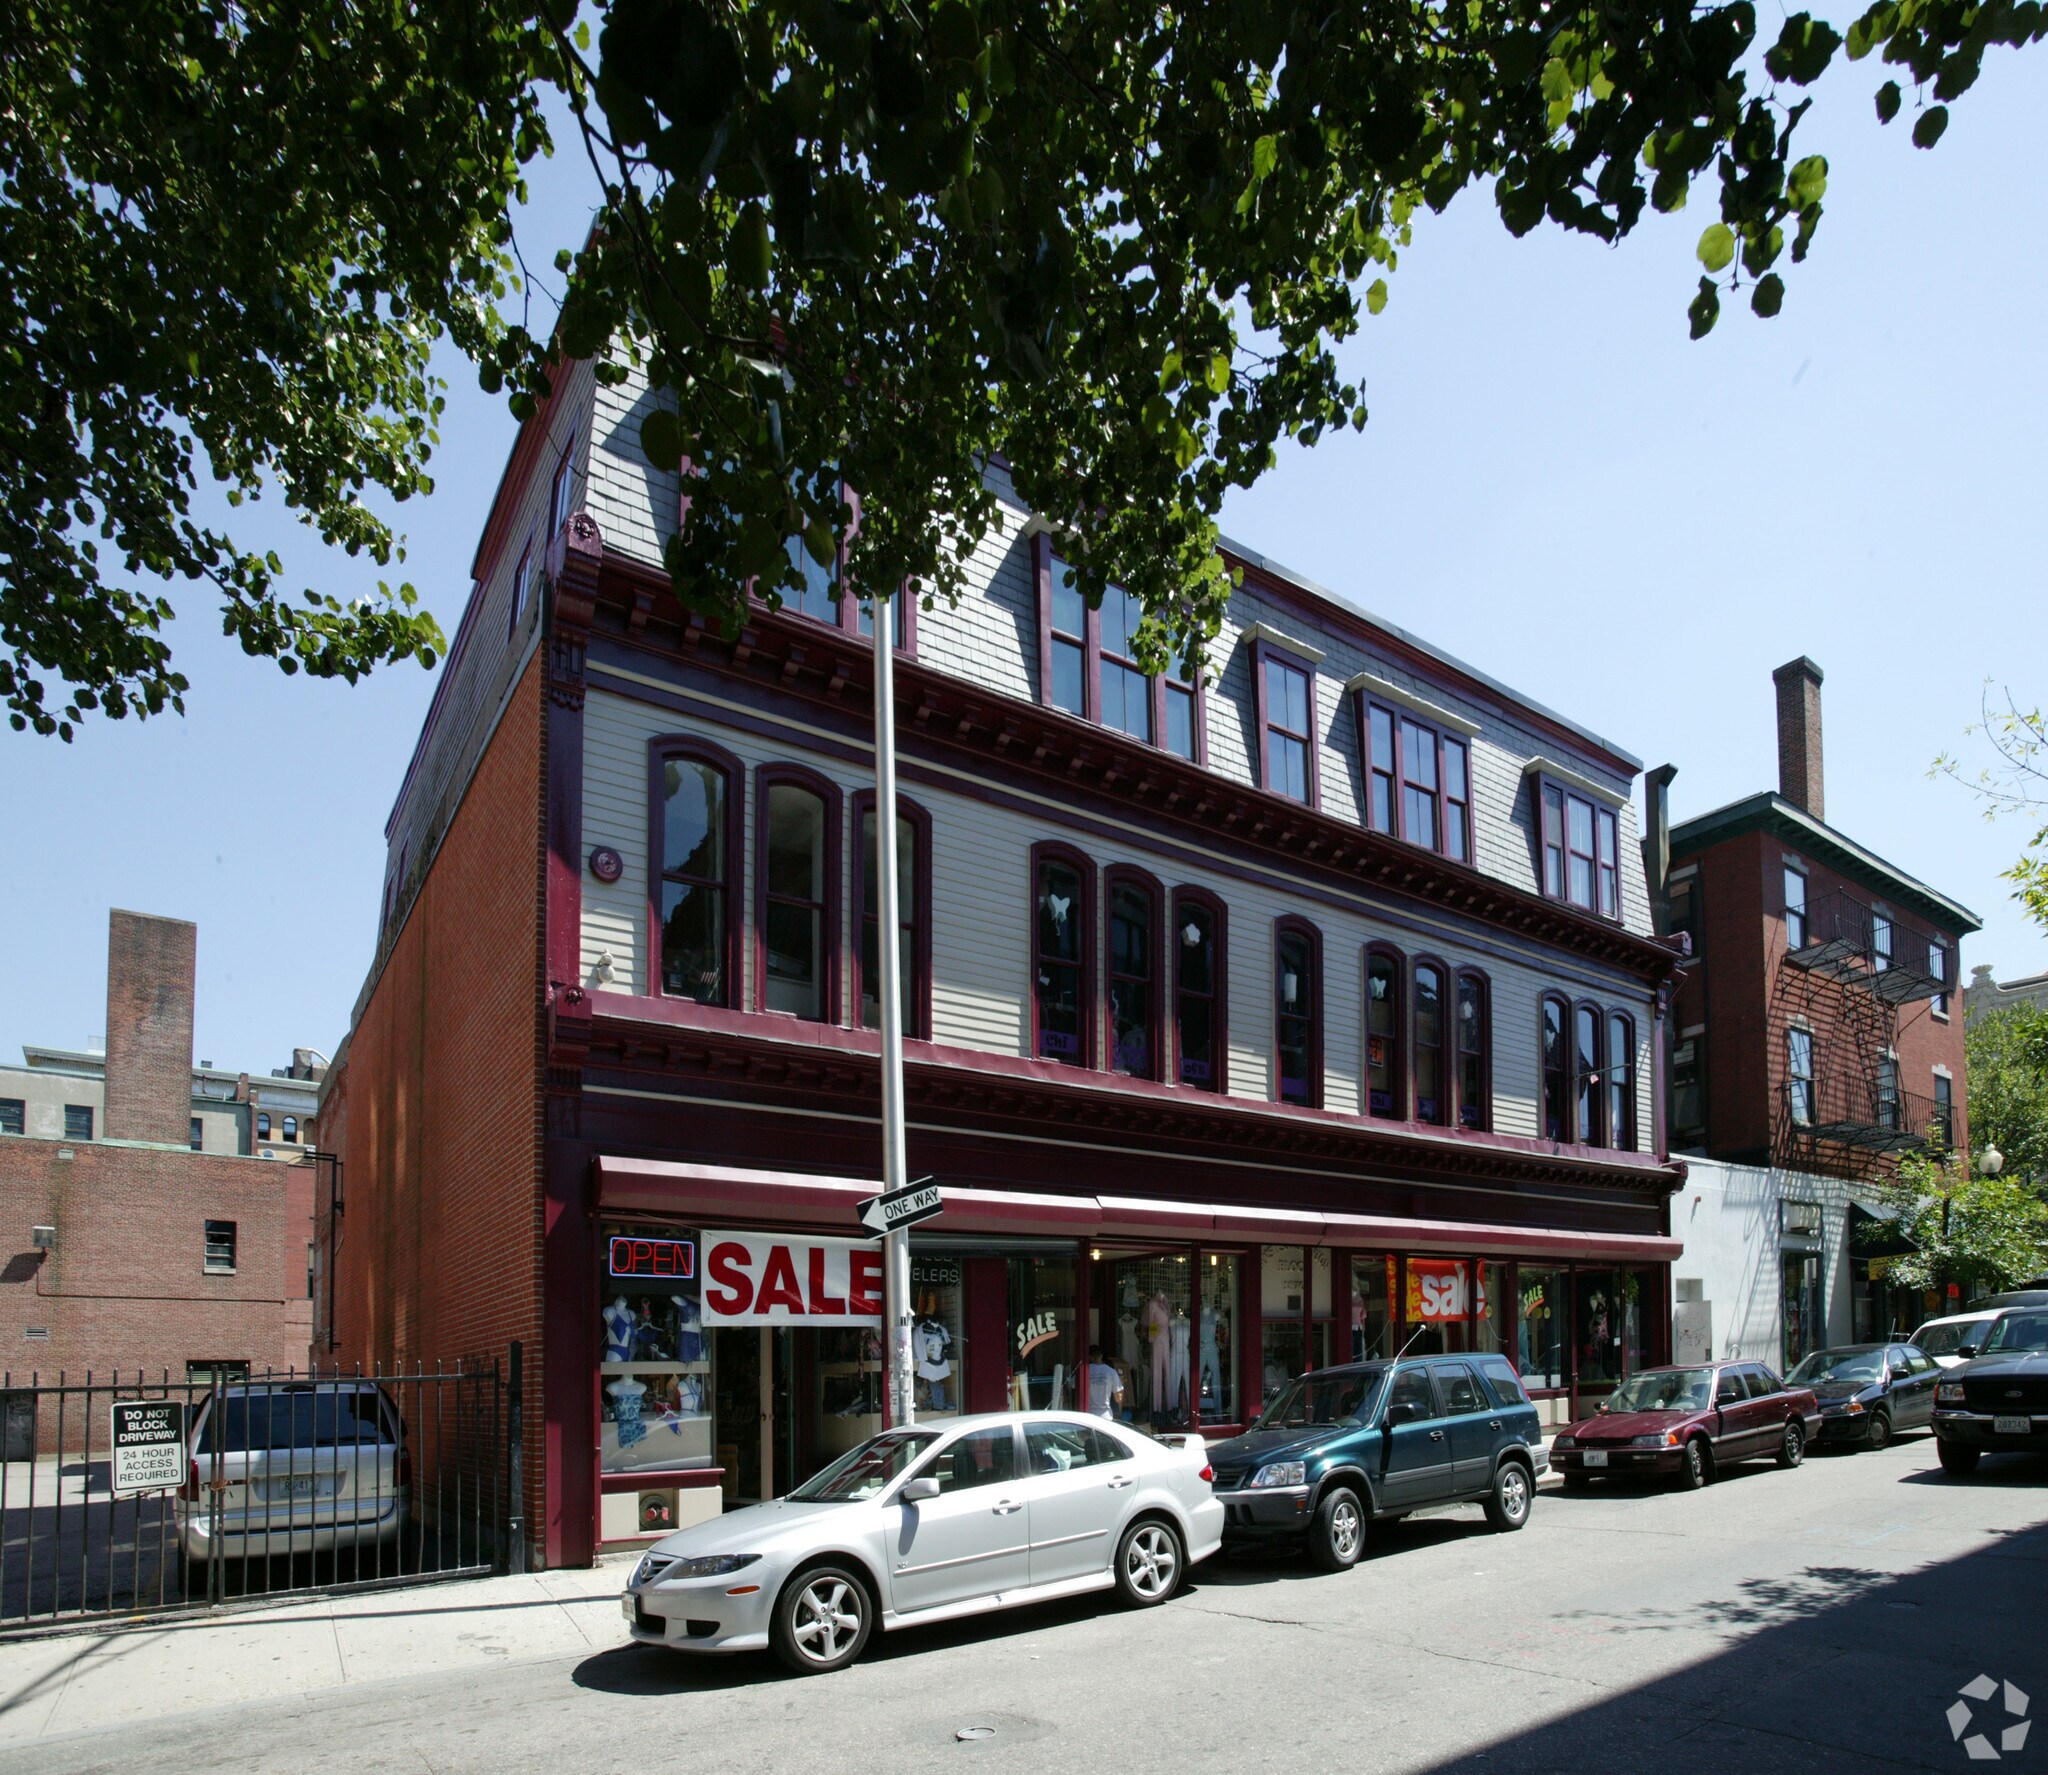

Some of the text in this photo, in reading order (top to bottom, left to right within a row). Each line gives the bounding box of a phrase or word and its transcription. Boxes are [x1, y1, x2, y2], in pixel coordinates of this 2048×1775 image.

[884, 1187, 938, 1219] ONE WAY
[612, 1240, 692, 1275] OPEN
[706, 1241, 882, 1316] SALE
[912, 1267, 960, 1283] ELERS
[1421, 1263, 1485, 1316] sale
[1523, 1284, 1543, 1311] SALE
[1016, 1311, 1057, 1350] SALE
[124, 1409, 171, 1420] DO NOT
[127, 1420, 168, 1431] BLOCK
[119, 1430, 177, 1443] DRIVEWAY
[122, 1447, 175, 1460] 24 HOUR
[125, 1458, 173, 1471] ACCESS
[119, 1469, 178, 1482] REQUIRED
